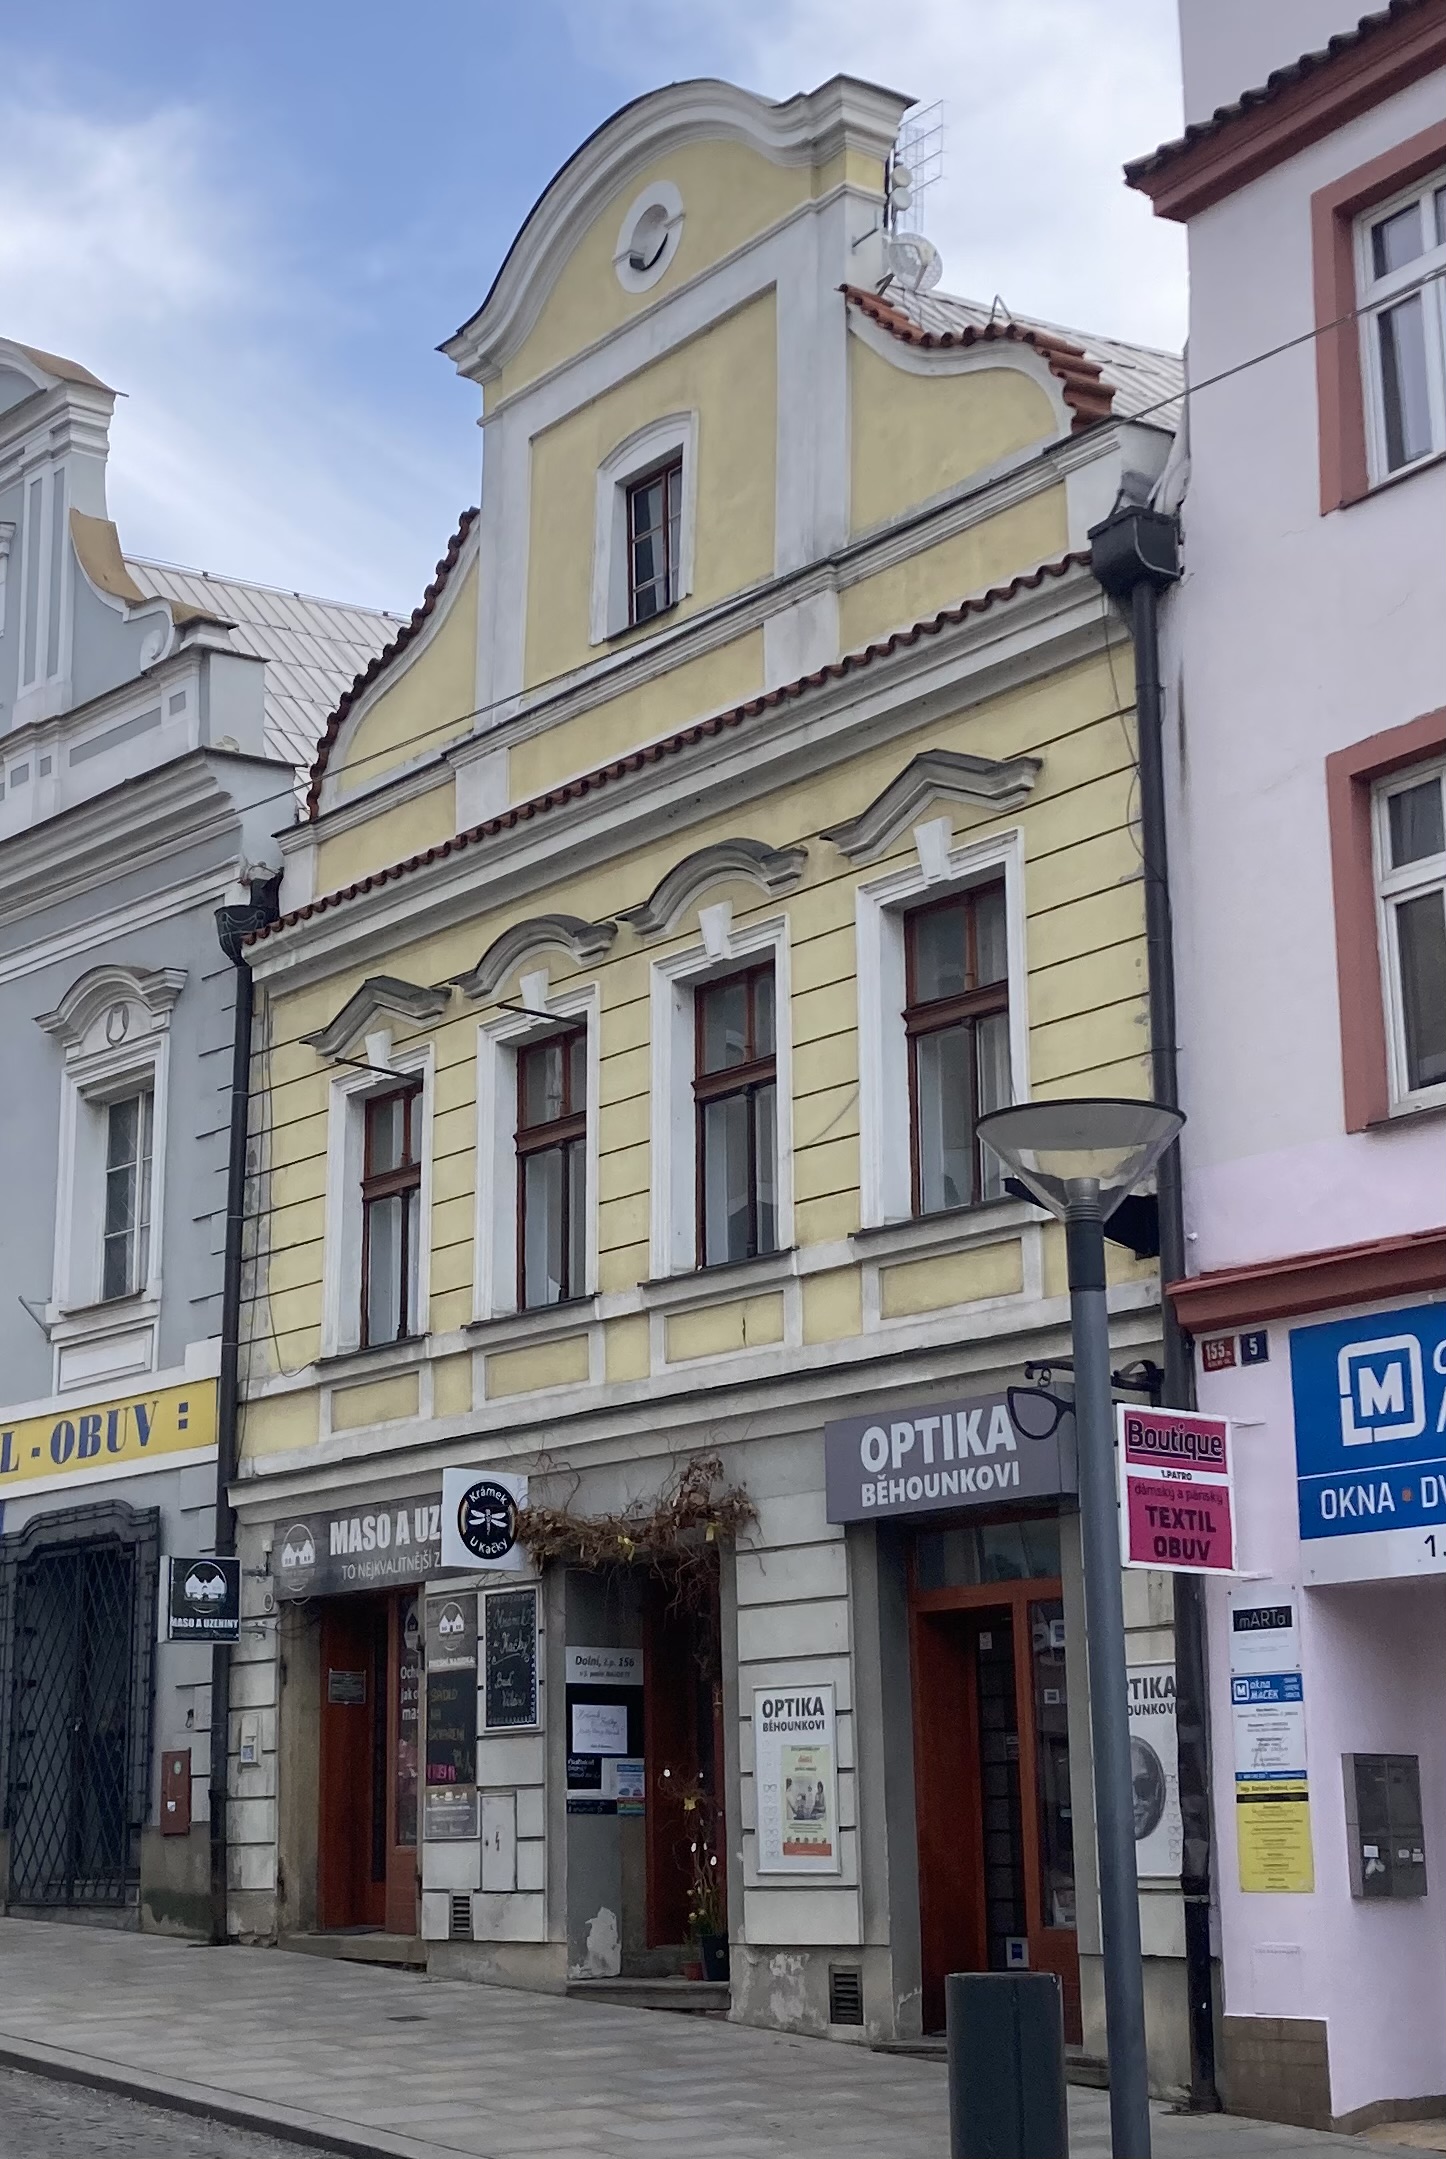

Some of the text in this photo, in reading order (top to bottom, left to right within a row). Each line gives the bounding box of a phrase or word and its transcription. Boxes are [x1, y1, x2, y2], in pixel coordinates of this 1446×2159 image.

[1249, 1337, 1258, 1356] 5
[860, 1404, 1017, 1473] OPTIKA
[1128, 1418, 1223, 1461] Boutique
[861, 1460, 1020, 1508] BĚHOUNKOVI
[1320, 1481, 1396, 1520] OKNA
[1144, 1504, 1217, 1533] TEXTIL
[330, 1513, 392, 1556] MASO
[396, 1510, 410, 1546] A
[1153, 1535, 1211, 1561] OBUV
[341, 1563, 356, 1580] TO
[1128, 1676, 1177, 1700] TIKA
[761, 1696, 825, 1718] OPTIKA
[762, 1719, 825, 1732] BĚHOUNKOVI
